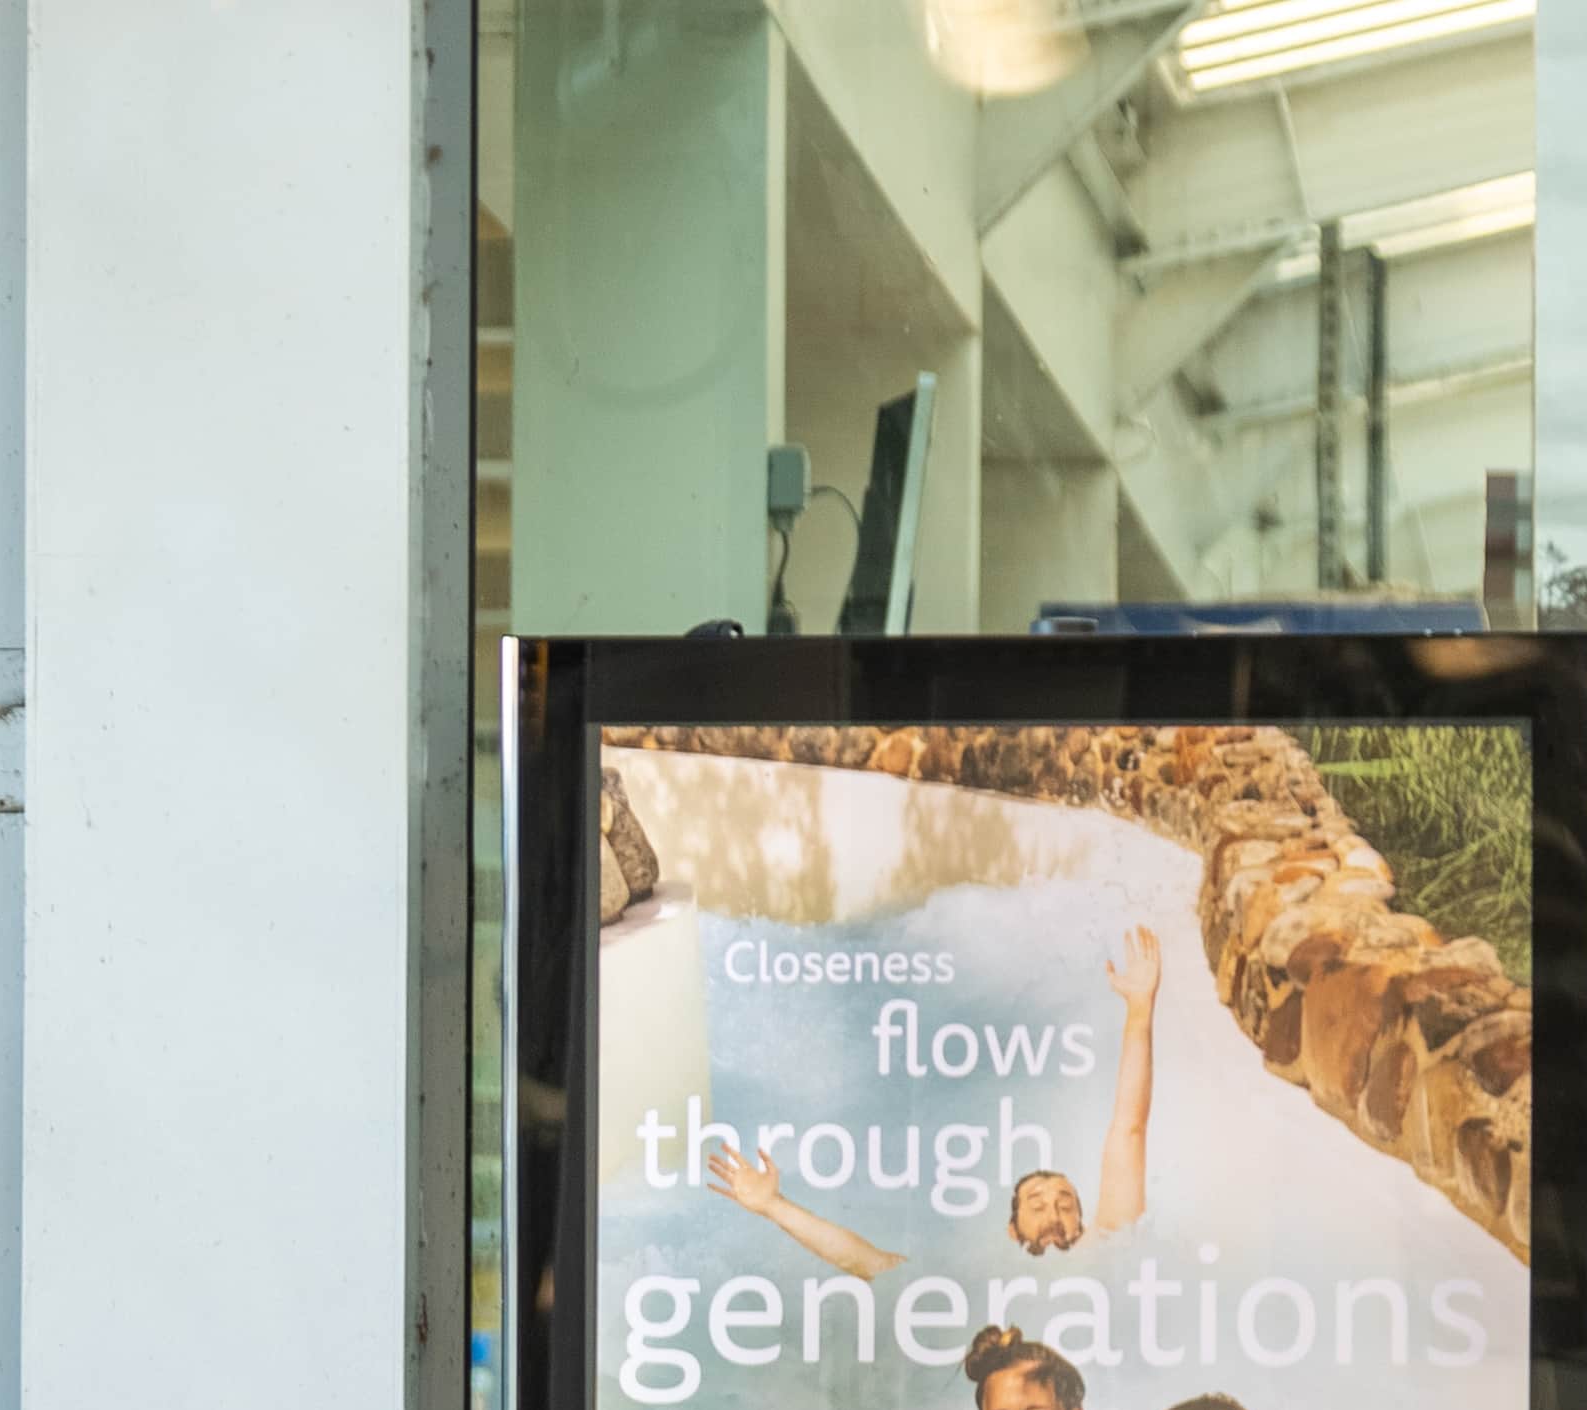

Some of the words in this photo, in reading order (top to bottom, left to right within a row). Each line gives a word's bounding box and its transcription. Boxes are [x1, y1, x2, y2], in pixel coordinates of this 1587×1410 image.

[724, 941, 956, 985] Closeness
[873, 998, 1097, 1079] flows
[636, 1096, 1055, 1218] through
[617, 1244, 1489, 1404] generations
